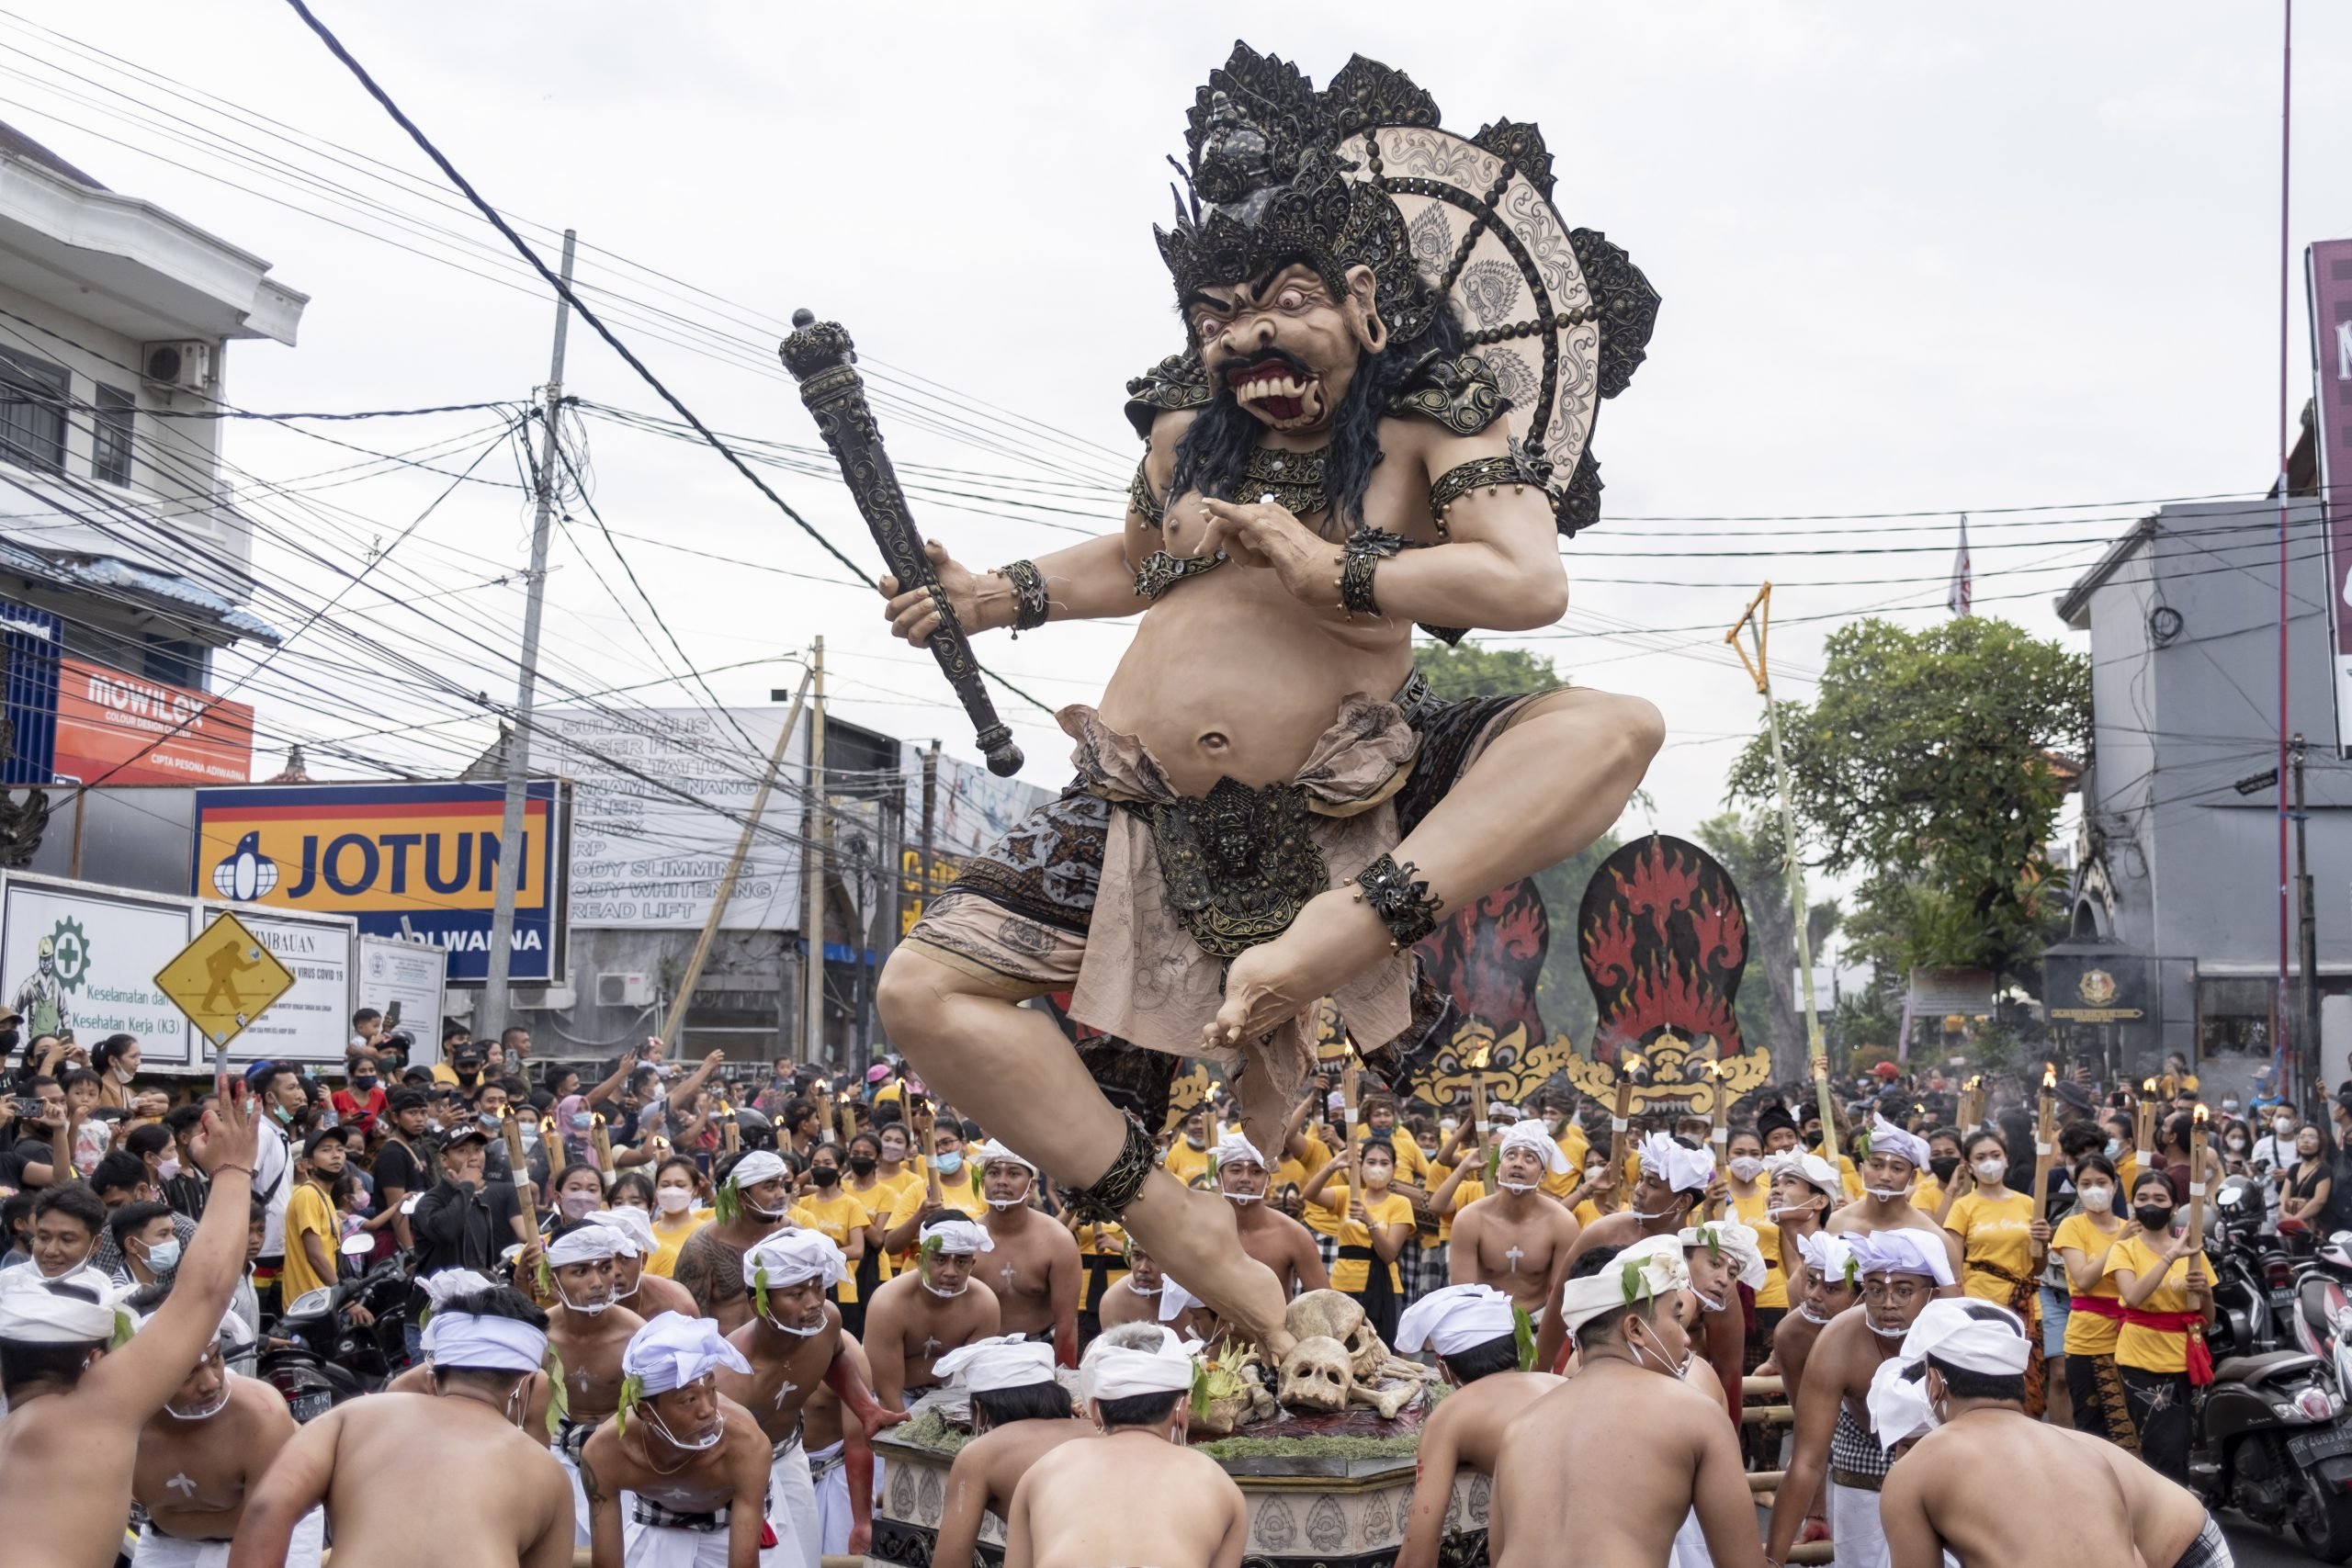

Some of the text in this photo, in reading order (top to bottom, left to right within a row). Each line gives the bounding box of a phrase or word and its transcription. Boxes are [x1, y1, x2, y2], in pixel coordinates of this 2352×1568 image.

[106, 710, 137, 727] COLOUR
[137, 716, 164, 732] DESIGN
[561, 739, 644, 756] LASER
[152, 753, 245, 781] CIPTA PESONA ADIWARNA
[649, 759, 728, 774] TATTO
[575, 779, 645, 795] ANAM
[577, 800, 644, 817] ILLER
[574, 820, 645, 838] OTOX
[573, 840, 606, 857] RP
[287, 831, 528, 898] JOTUN
[572, 862, 626, 878] ODY
[572, 883, 626, 898] ODY
[642, 903, 696, 919] LIFT
[442, 930, 543, 952] WANA
[298, 966, 315, 979] VIRUS
[317, 969, 334, 981] COVID
[336, 970, 344, 982] 19
[86, 984, 169, 1007] Keselamatan dan
[73, 1012, 180, 1035] Kesehatan Kerja (K3)
[2290, 1438, 2308, 1454] DK
[2309, 1432, 2335, 1447] 4689
